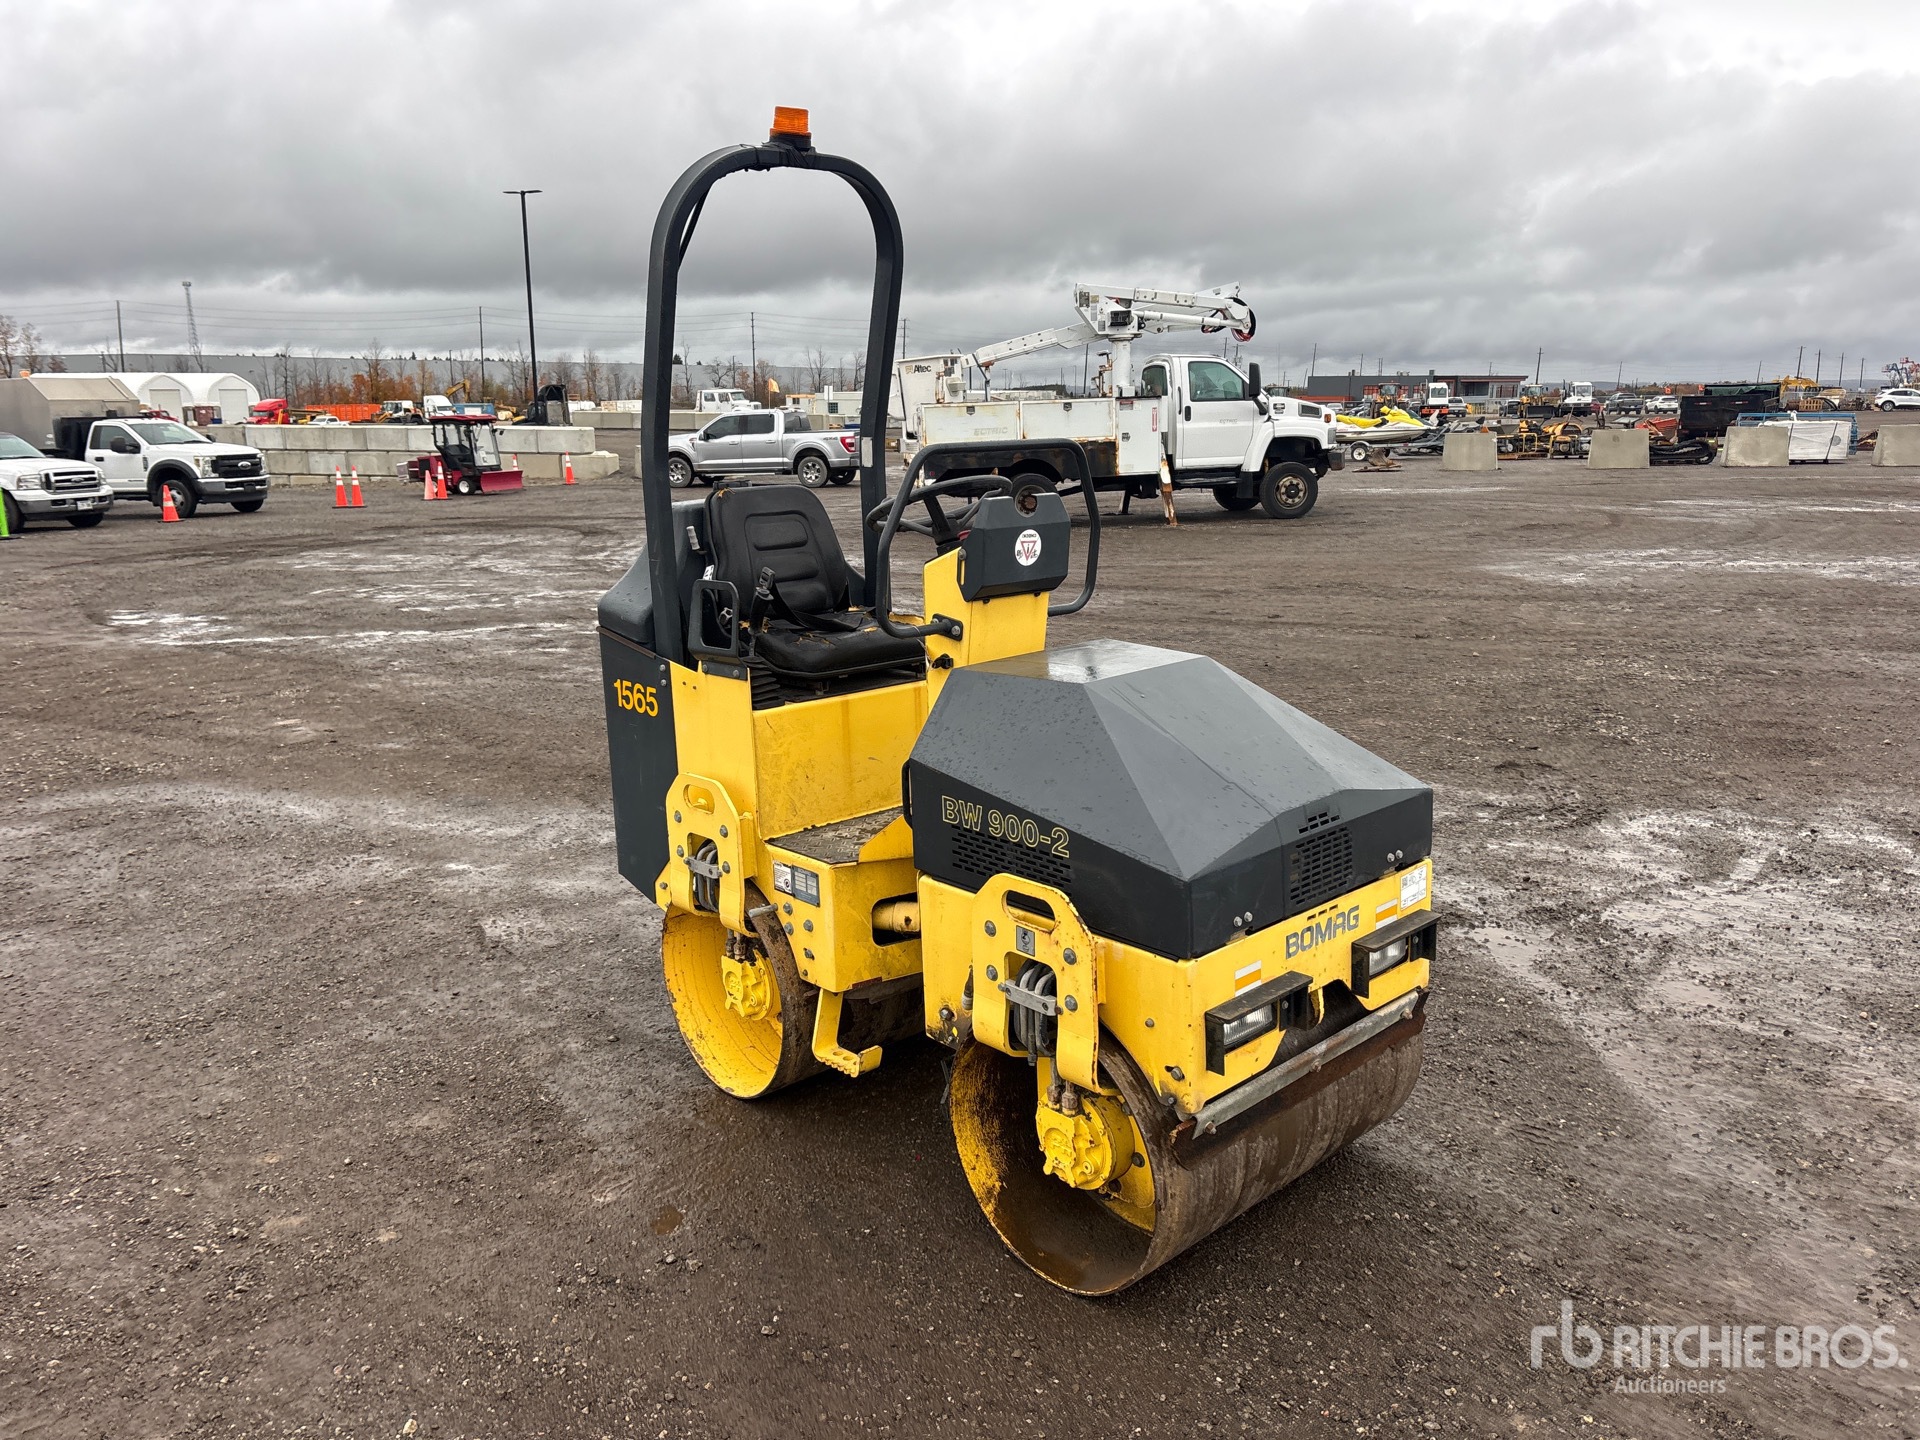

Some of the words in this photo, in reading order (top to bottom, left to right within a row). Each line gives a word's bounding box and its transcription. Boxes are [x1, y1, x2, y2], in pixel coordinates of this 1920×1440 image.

[913, 364, 932, 374] Altec
[613, 678, 659, 717] 1565
[941, 795, 983, 832] BW
[987, 809, 1070, 858] 900-2
[1285, 904, 1360, 960] BOMAG
